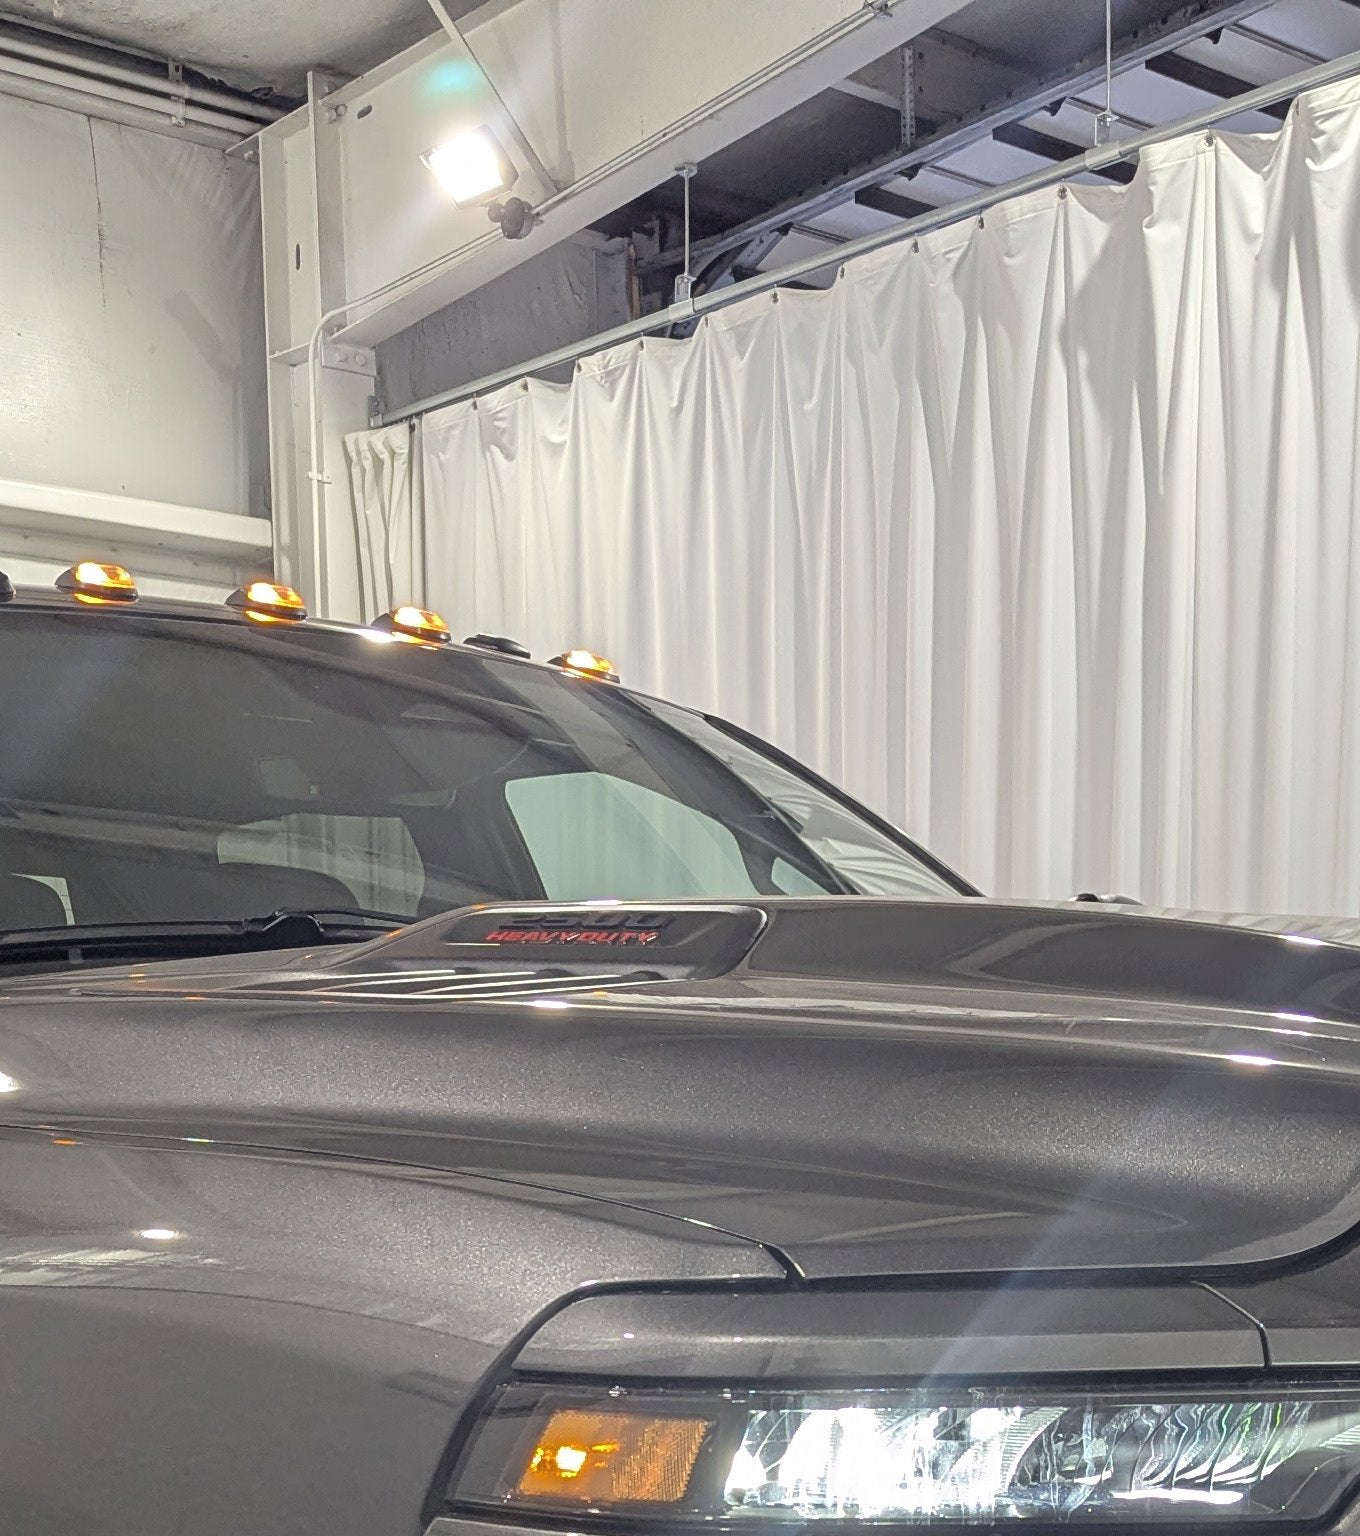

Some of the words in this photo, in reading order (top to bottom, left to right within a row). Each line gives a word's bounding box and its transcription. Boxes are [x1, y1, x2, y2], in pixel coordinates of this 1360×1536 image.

[498, 912, 675, 930] 2500
[486, 931, 579, 945] HEAVY
[580, 931, 657, 946] DUTY
